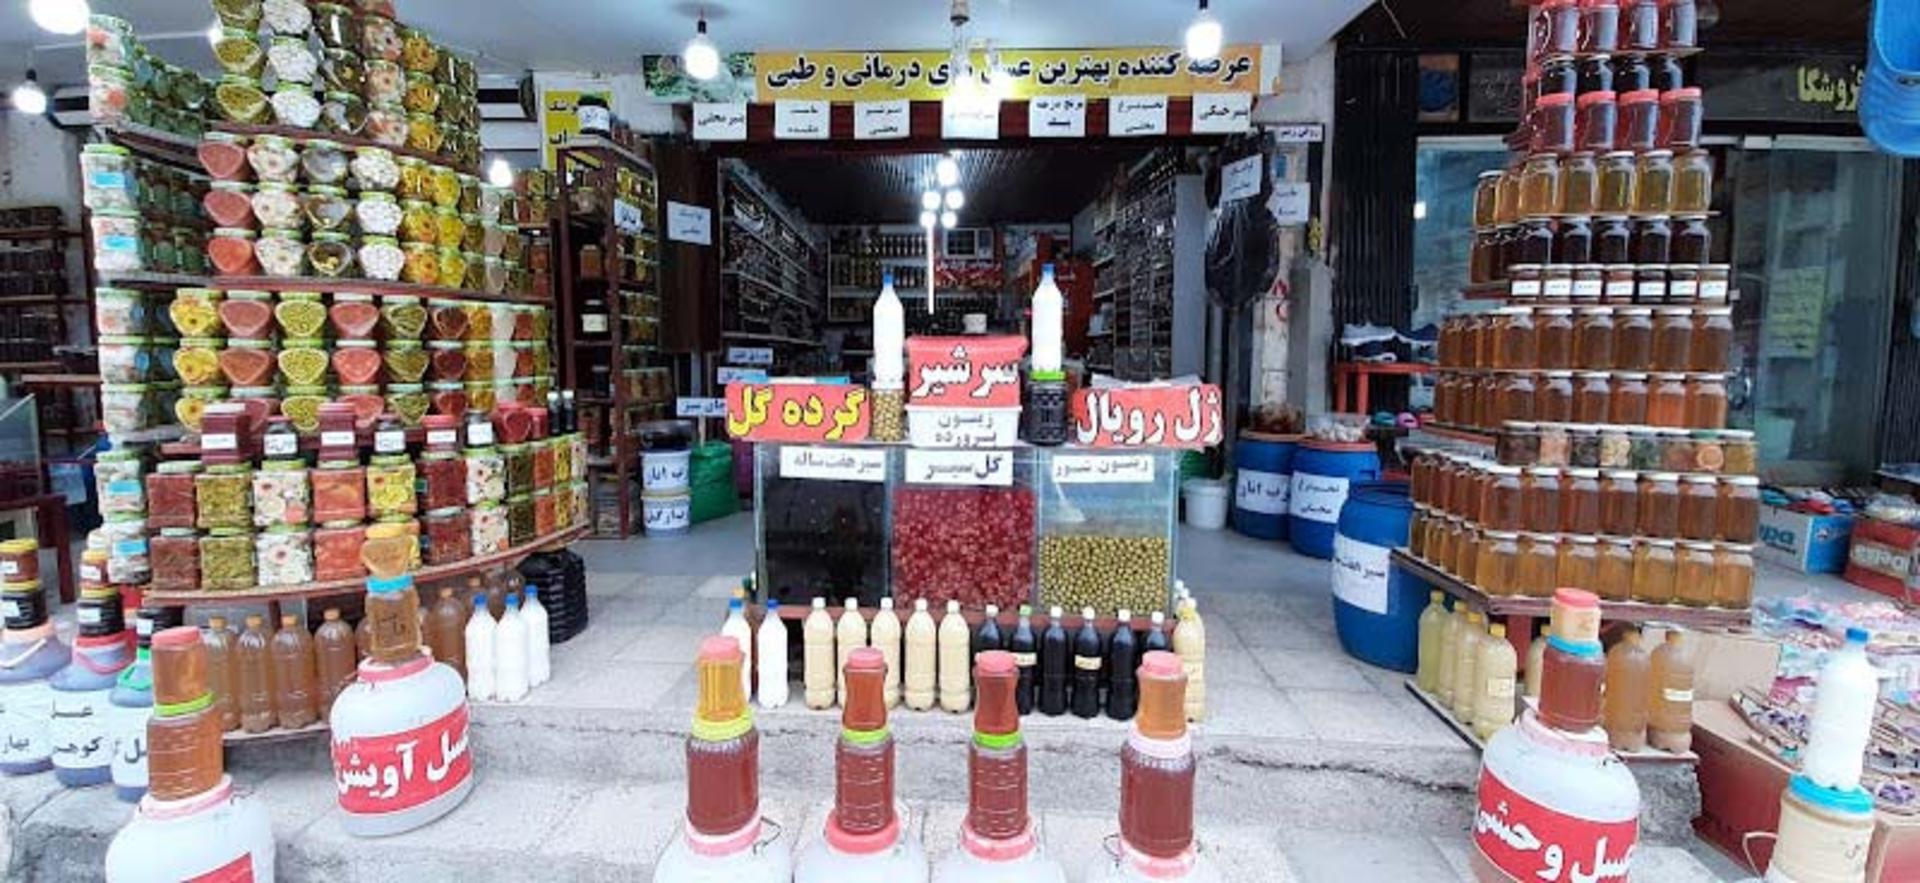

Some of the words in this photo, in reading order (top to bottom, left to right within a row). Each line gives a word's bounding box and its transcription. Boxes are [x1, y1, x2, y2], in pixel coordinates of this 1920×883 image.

[767, 57, 816, 87] طبی
[824, 66, 836, 87] و
[842, 56, 921, 87] درمانی
[1038, 58, 1110, 84] بهترین
[1118, 52, 1181, 77] کننده
[911, 345, 972, 398] شیر
[970, 361, 1019, 398] سر
[728, 383, 775, 437] گل
[782, 387, 867, 440] گرده
[938, 414, 994, 429] زیتون
[1077, 390, 1167, 444] رویال
[1175, 388, 1222, 442] ژل
[856, 457, 881, 473] سیر
[974, 454, 1003, 478] گل
[426, 729, 469, 782] سل
[1570, 836, 1638, 883] سل
